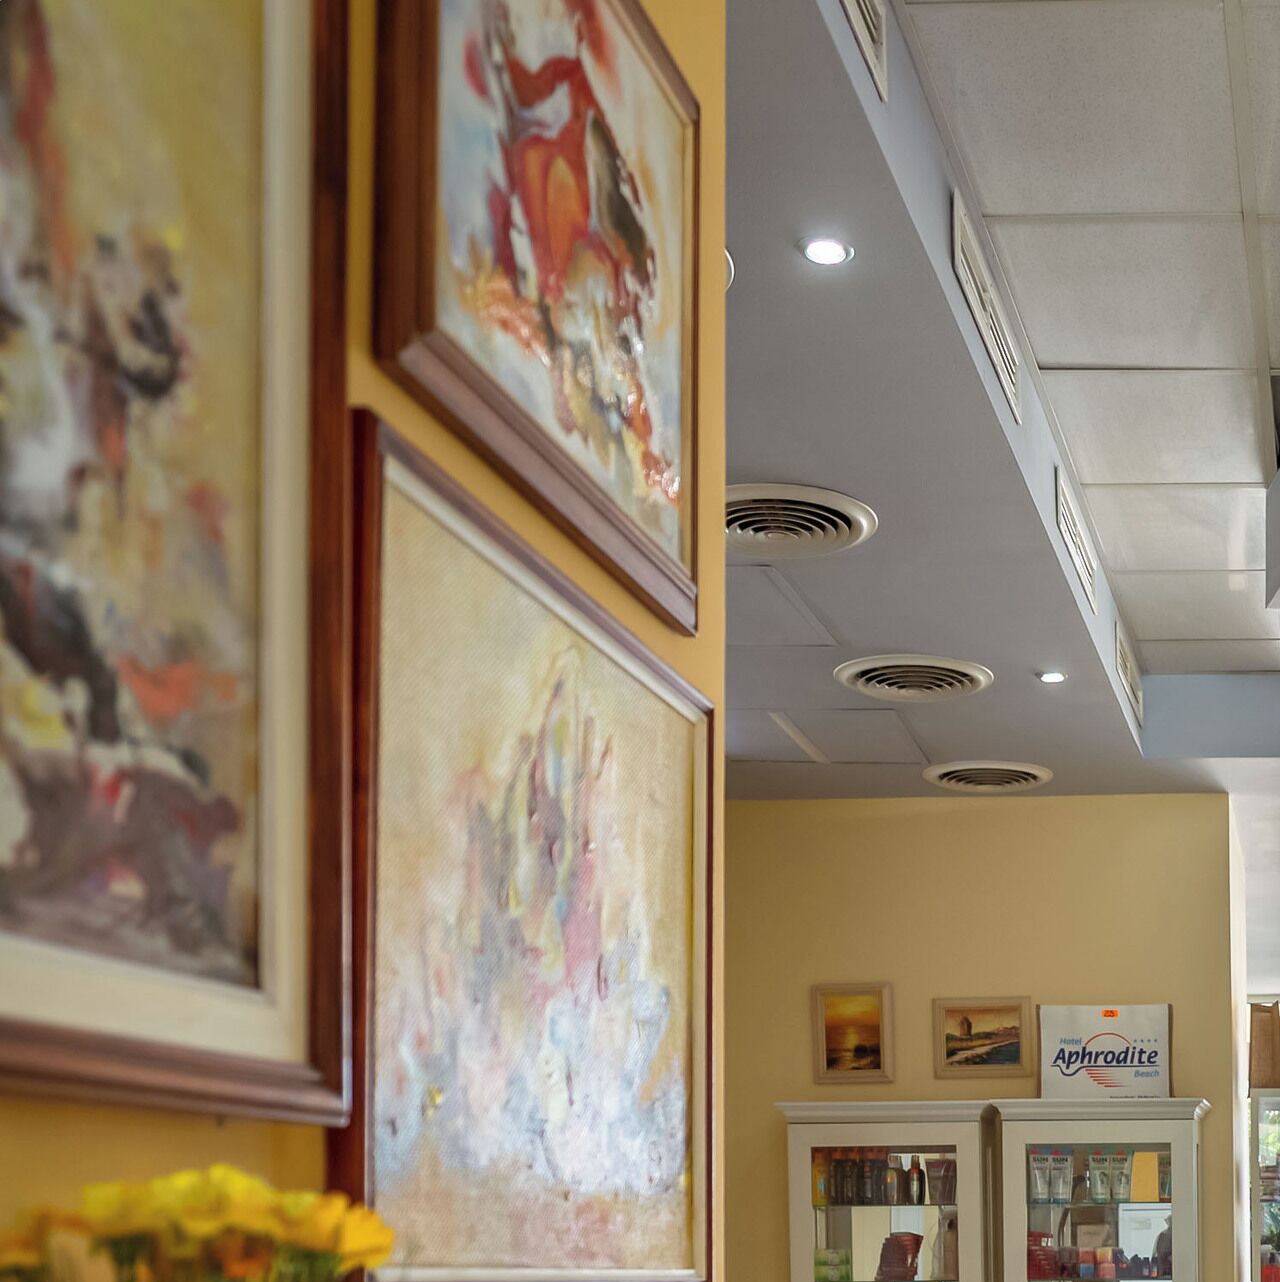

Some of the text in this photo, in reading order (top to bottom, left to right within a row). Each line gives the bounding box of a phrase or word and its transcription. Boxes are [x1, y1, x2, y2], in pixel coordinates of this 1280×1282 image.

[1060, 1037, 1083, 1046] Hotel
[1052, 1046, 1159, 1070] Aphrodite
[1134, 1069, 1160, 1078] Beach
